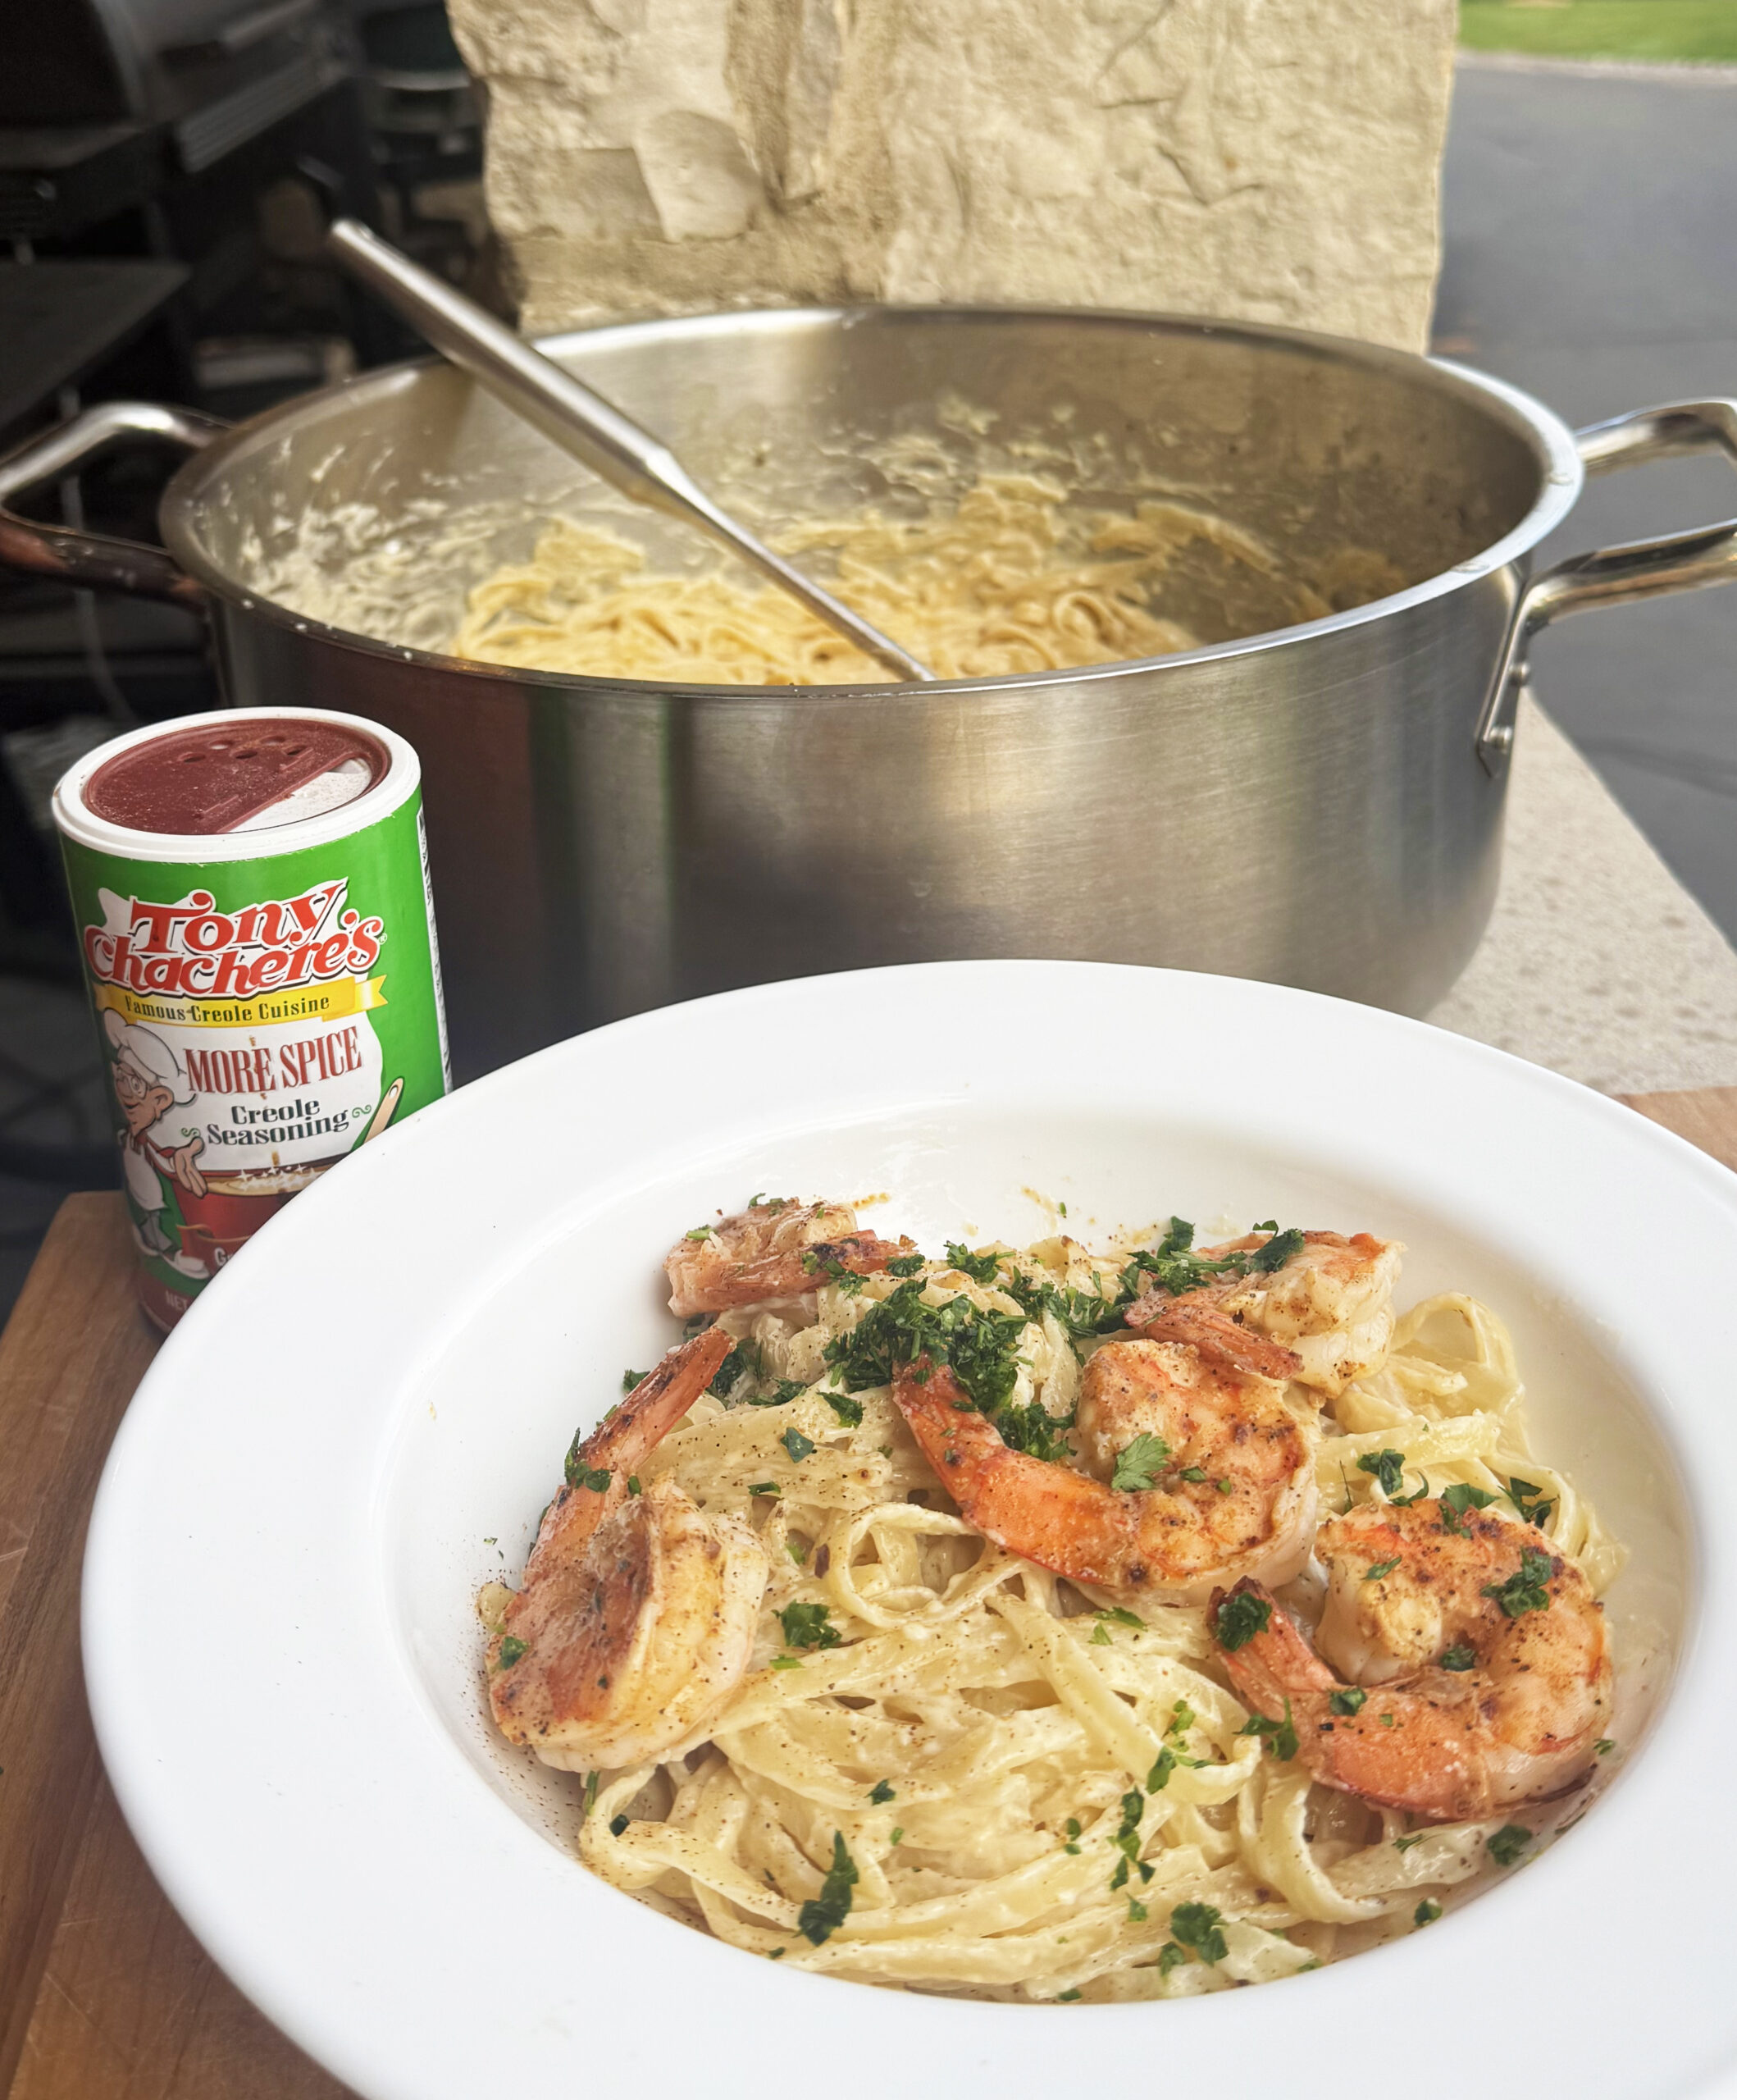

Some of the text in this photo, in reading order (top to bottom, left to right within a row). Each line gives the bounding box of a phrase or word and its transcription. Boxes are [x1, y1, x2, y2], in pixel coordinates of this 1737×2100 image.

[129, 880, 345, 954] Tony
[85, 911, 381, 994] Chachere's
[125, 994, 330, 1023] Famous Creole Cuisine
[183, 1025, 362, 1095] MORE SPICE
[207, 1108, 349, 1146] Seasoning
[230, 1098, 320, 1125] Creole
